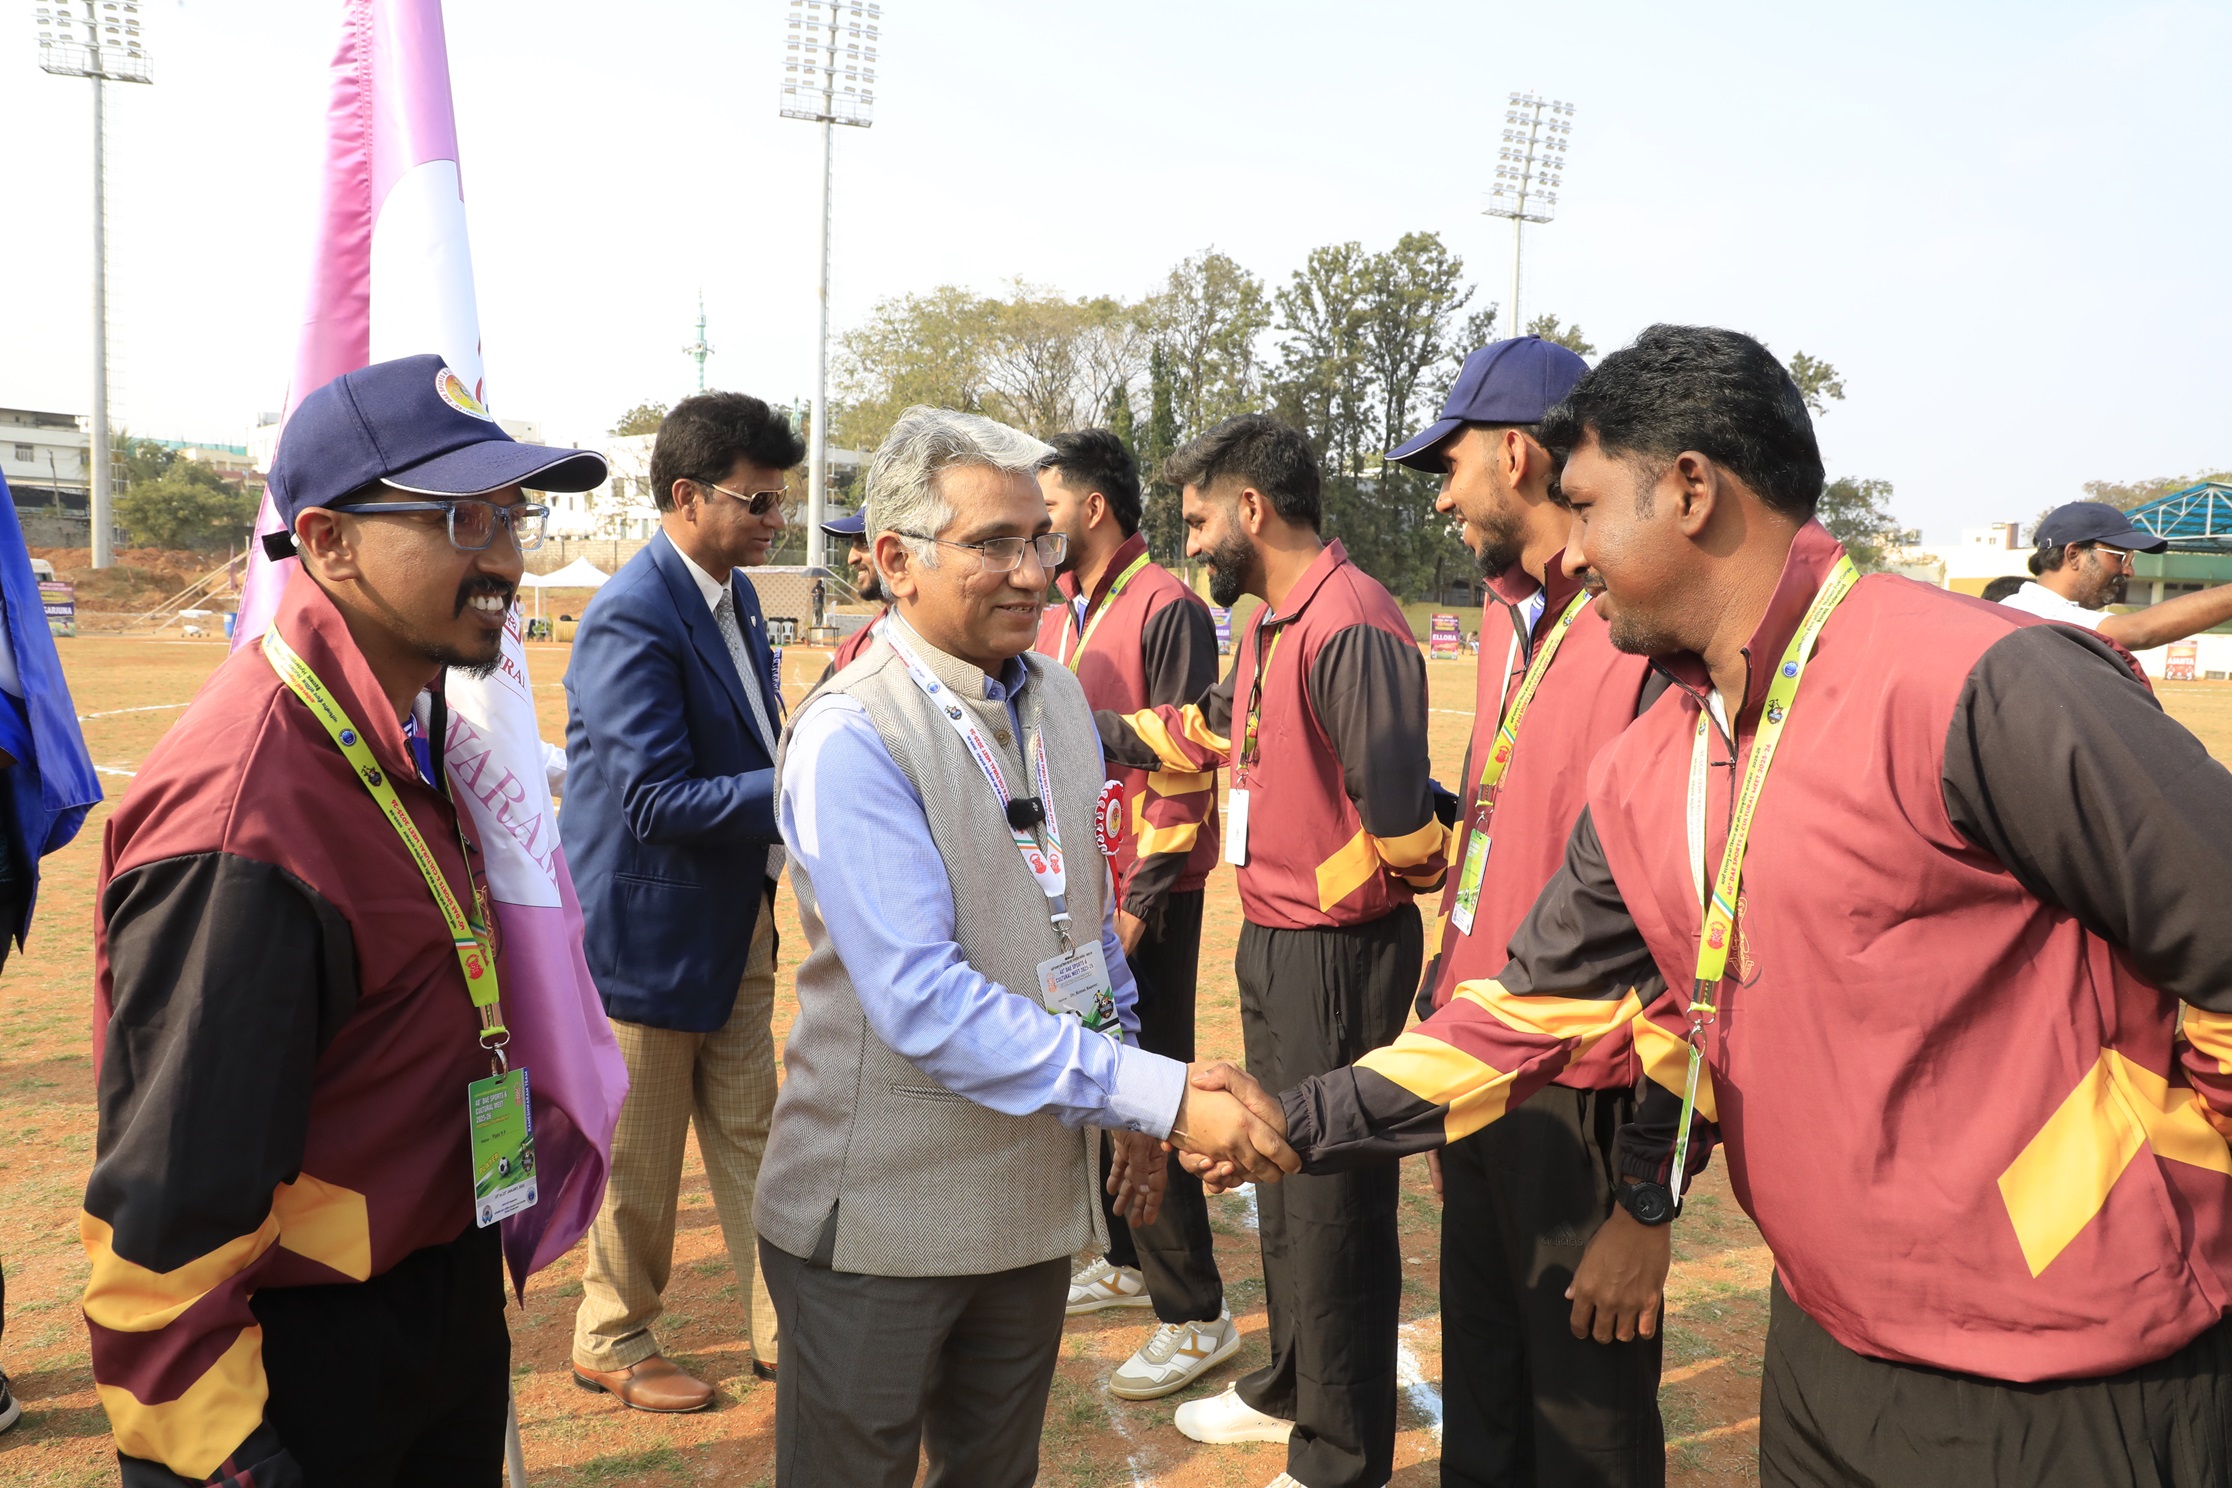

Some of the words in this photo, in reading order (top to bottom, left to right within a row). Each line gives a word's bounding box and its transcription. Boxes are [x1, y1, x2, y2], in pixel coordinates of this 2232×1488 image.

[2168, 657, 2195, 666] AJANTA
[968, 727, 984, 750] 2025-26
[981, 748, 992, 763] MEET
[1756, 742, 1772, 774] 2025-26
[989, 762, 1006, 789] CULTURAL
[1750, 774, 1761, 794] MEET
[389, 798, 411, 827] 2025-26
[1740, 794, 1754, 831] CULTURAL
[407, 825, 421, 844] MEET
[417, 842, 439, 876] CULTURAL
[1732, 839, 1743, 866] SPORTS
[1728, 866, 1737, 882] DAE
[437, 880, 454, 906] SPORTS
[450, 904, 461, 920] DAE
[1056, 974, 1071, 983] CULTURAL
[479, 1152, 500, 1173] PLAYER
